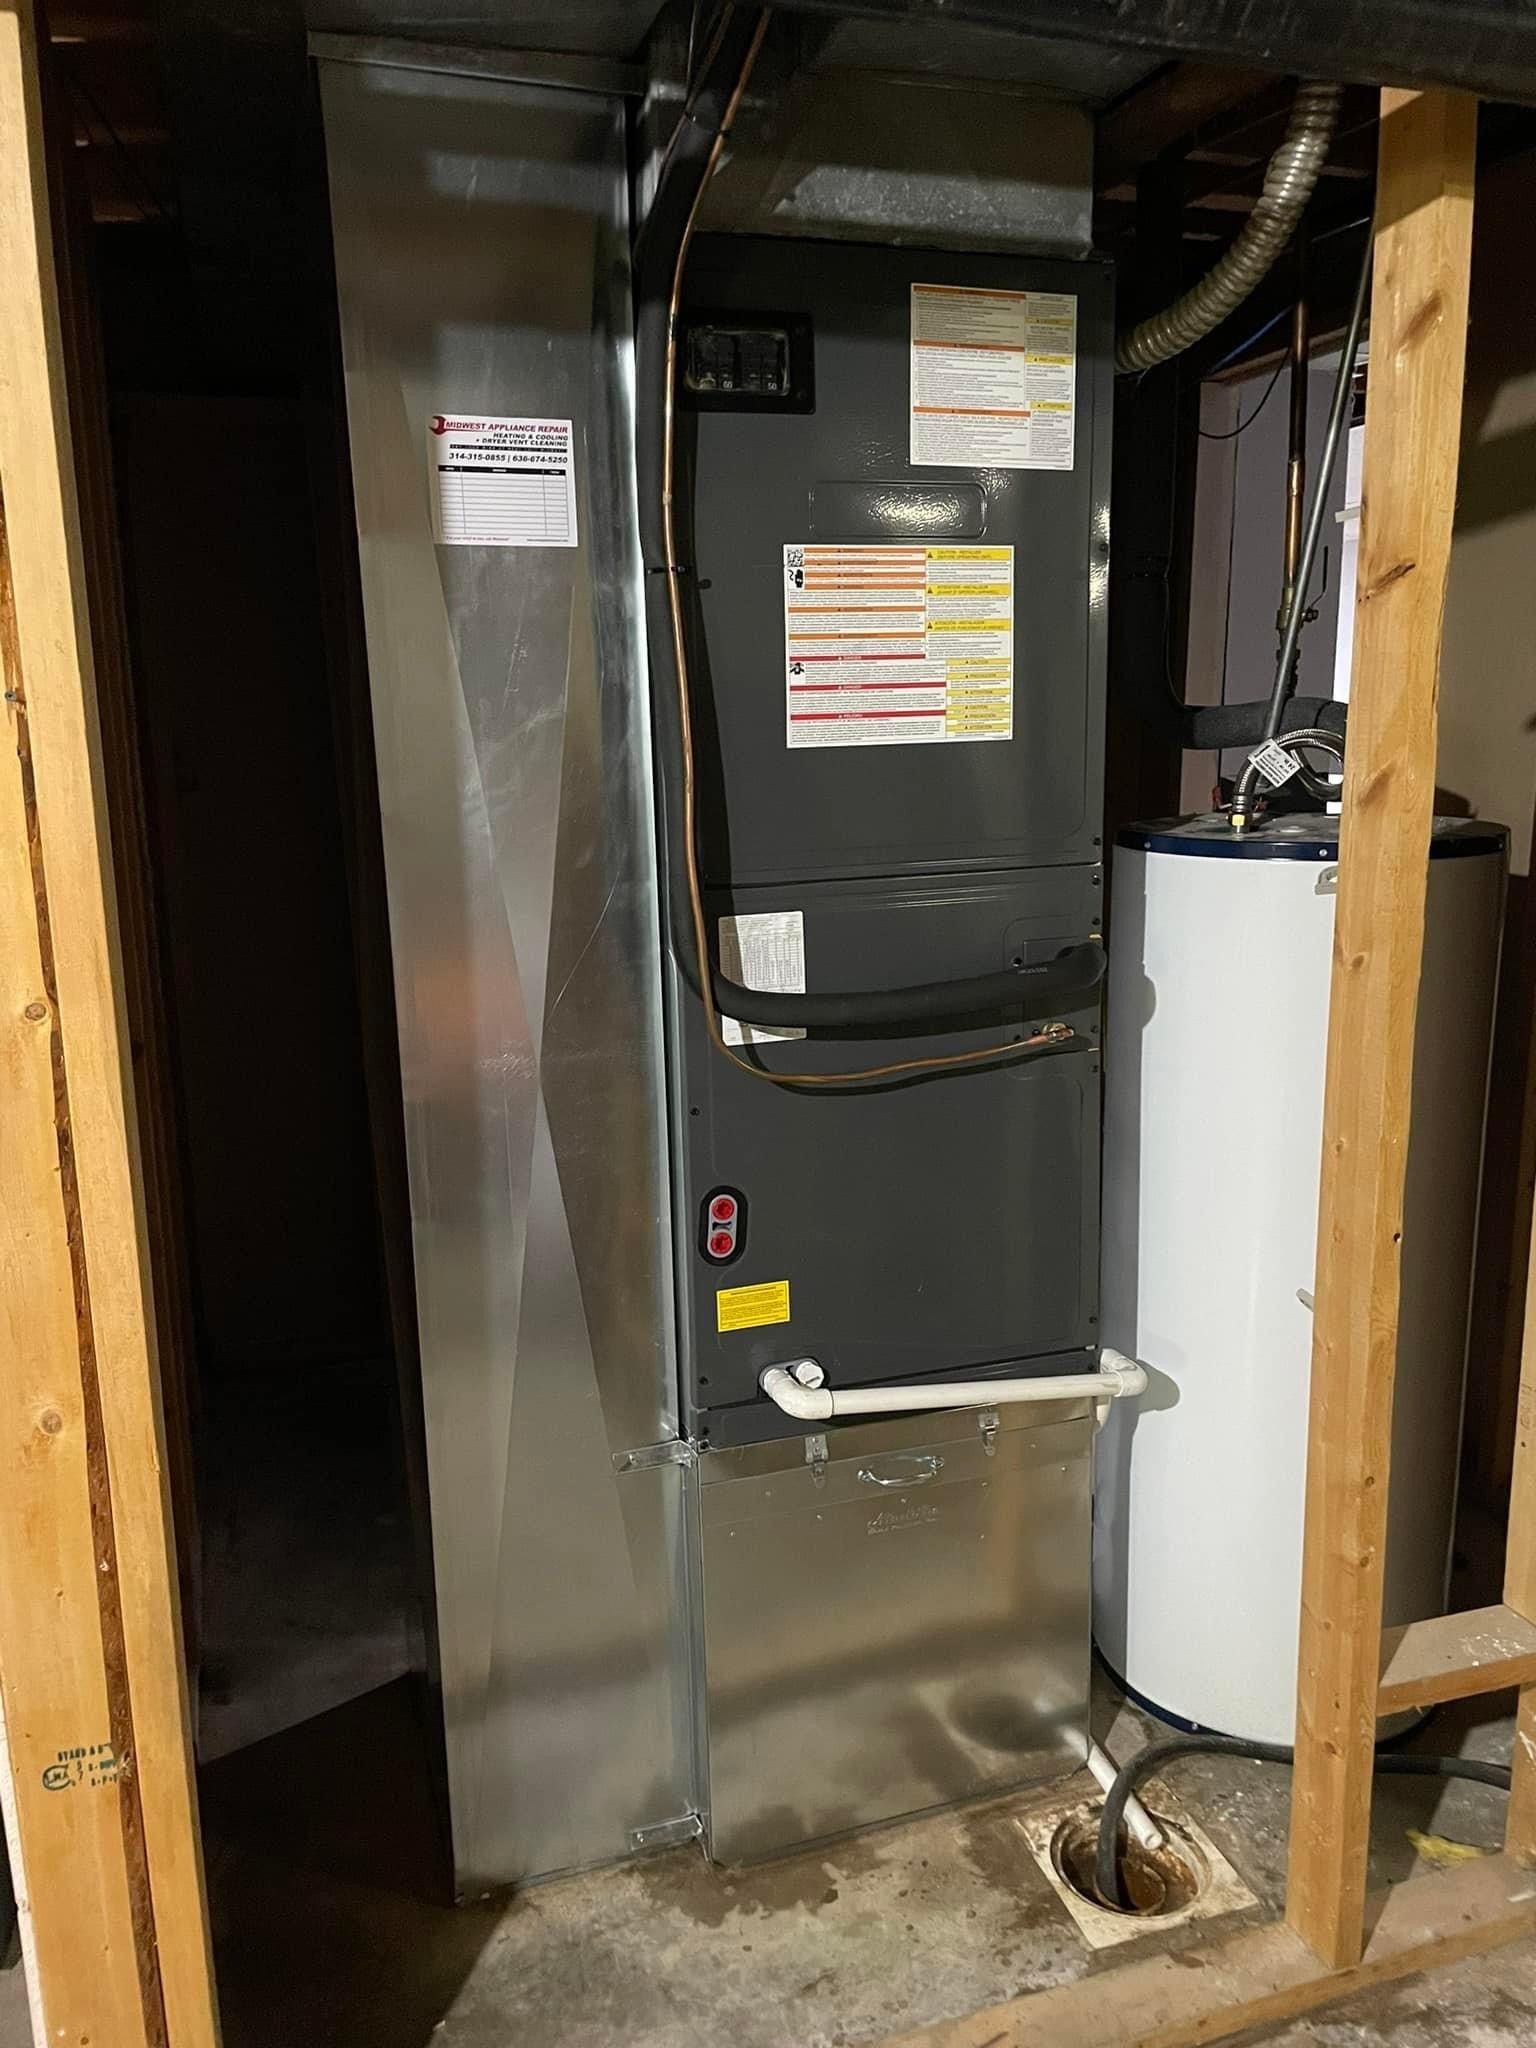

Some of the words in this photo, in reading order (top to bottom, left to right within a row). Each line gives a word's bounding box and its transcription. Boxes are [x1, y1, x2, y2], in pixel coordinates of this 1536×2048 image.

[445, 421, 487, 430] MIDWEST
[488, 423, 536, 432] APPLIANCE
[537, 425, 568, 433] REPAIR
[449, 453, 506, 461] 314-315-0855
